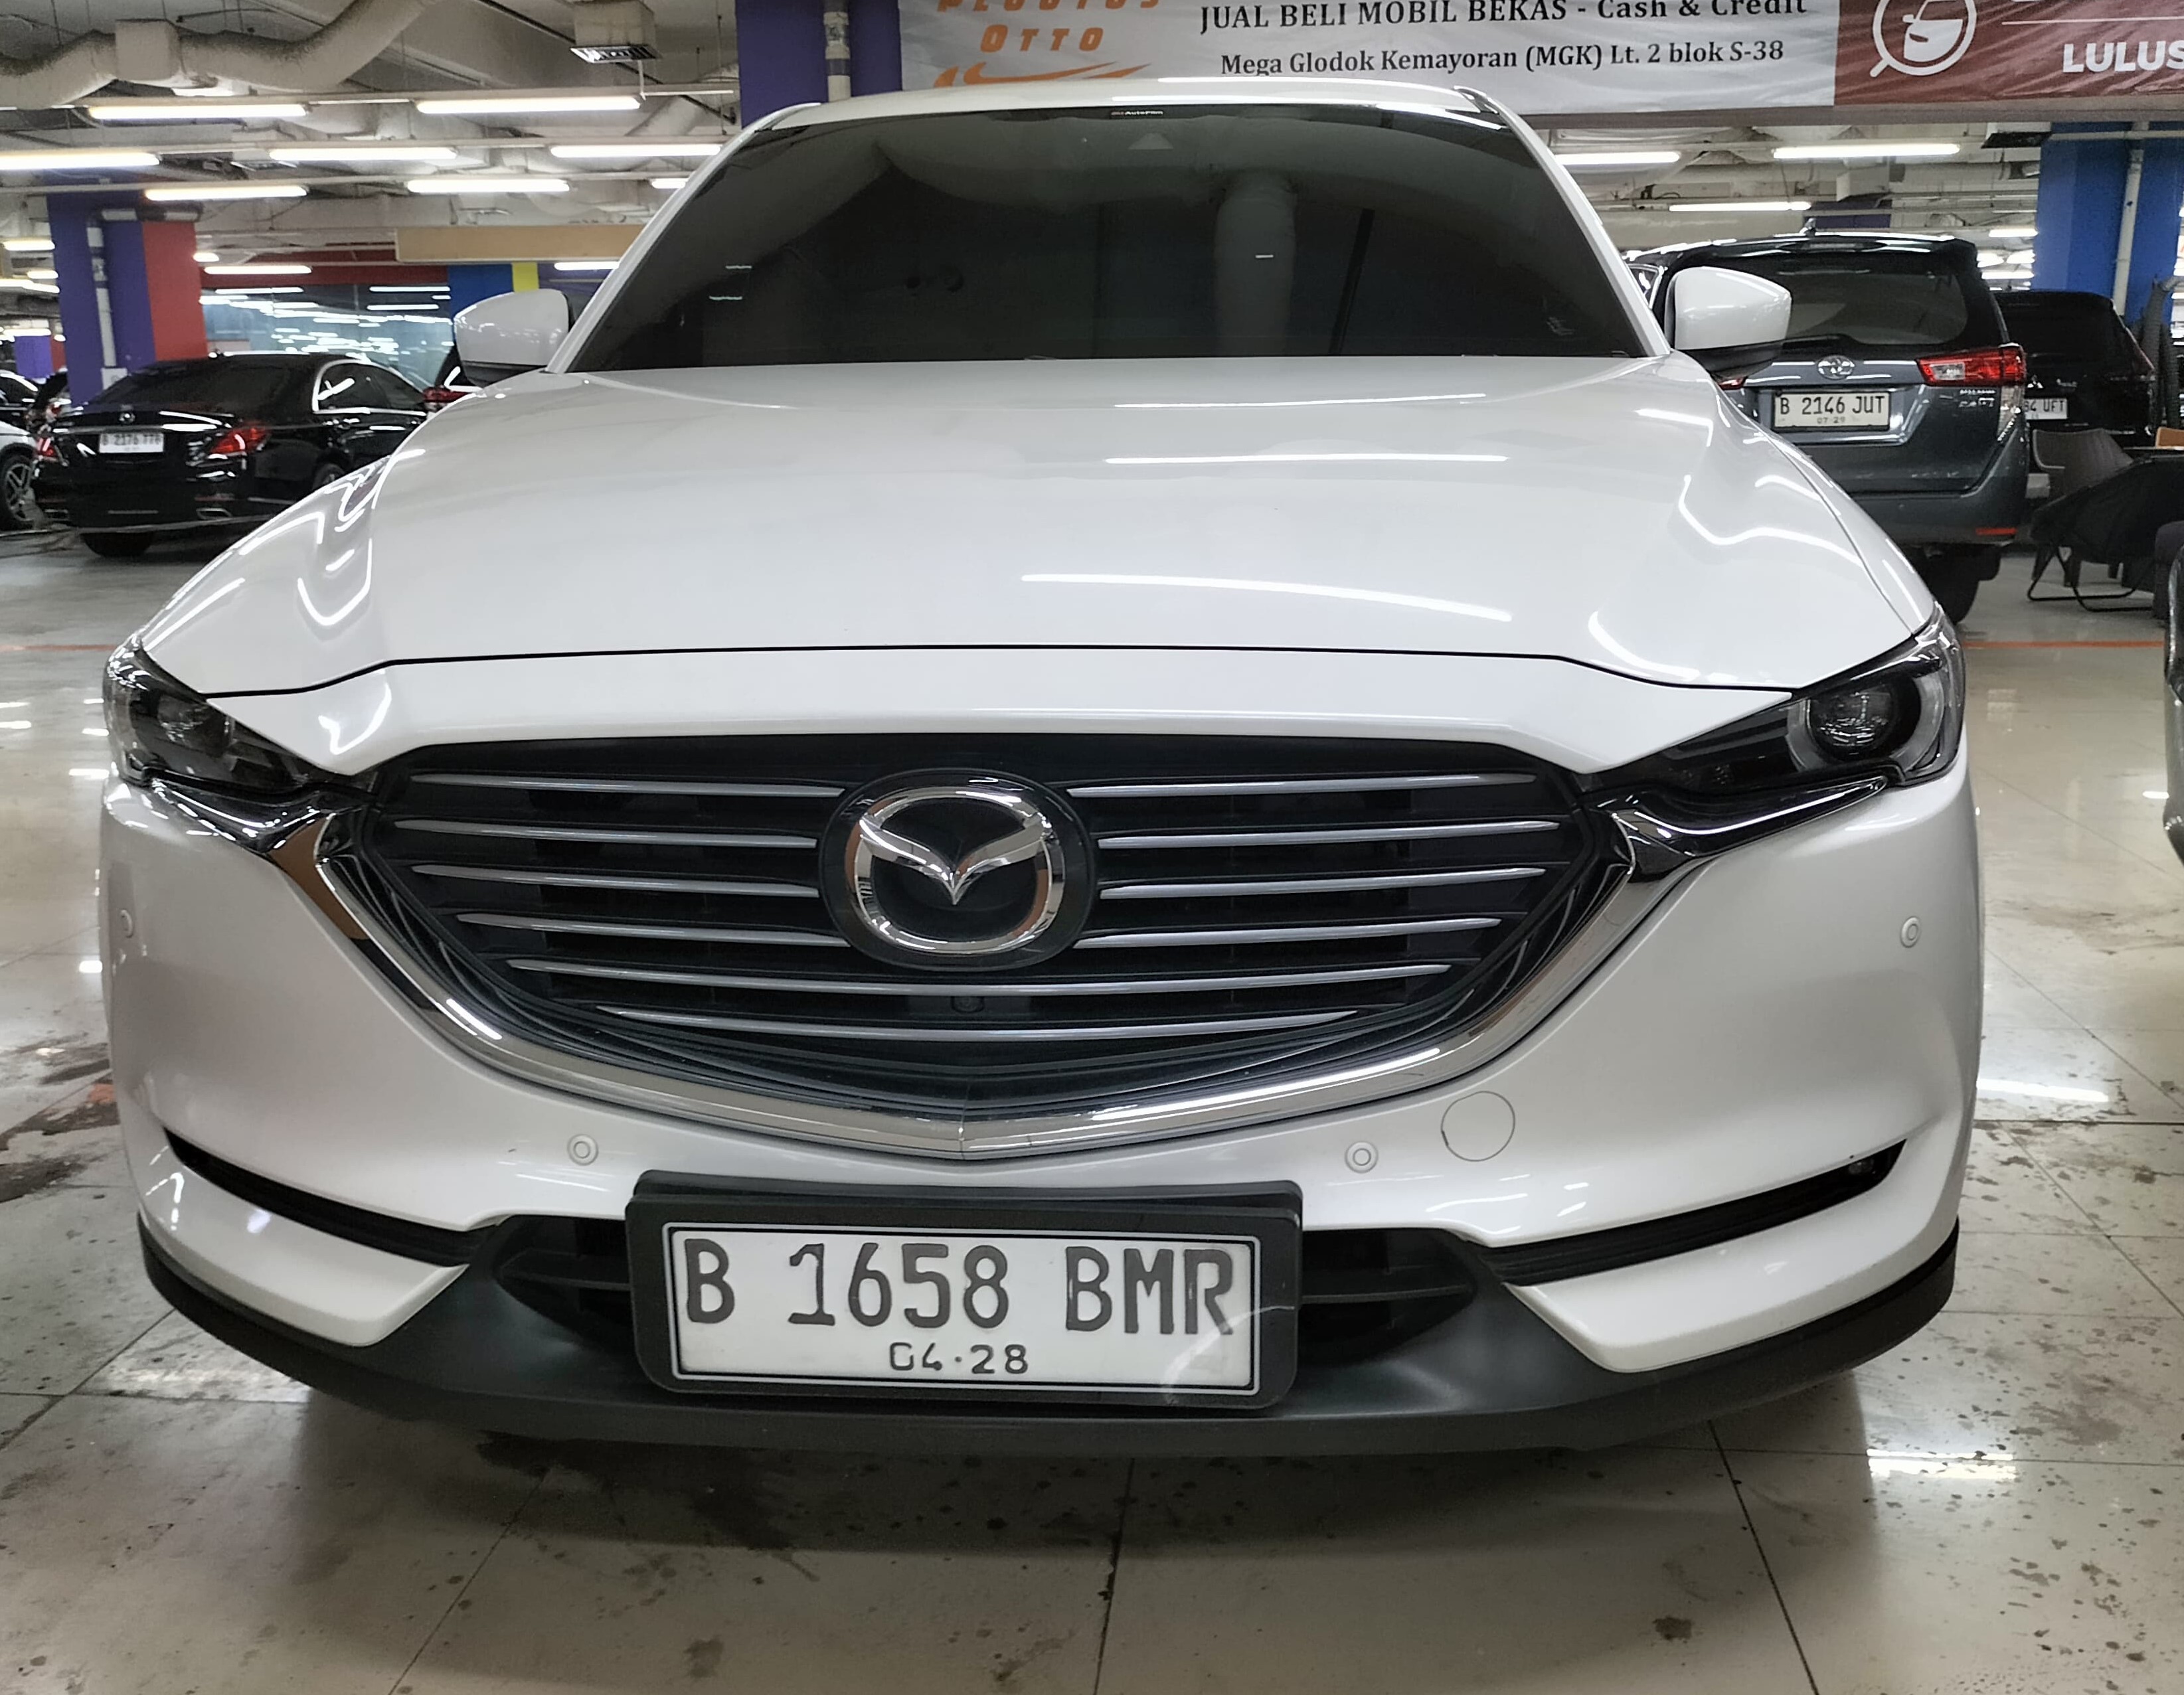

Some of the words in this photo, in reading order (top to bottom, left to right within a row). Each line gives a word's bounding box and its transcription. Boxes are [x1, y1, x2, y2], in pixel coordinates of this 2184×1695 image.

[1201, 5, 1270, 35] JUAL
[1280, 3, 1347, 28] BELI
[1358, 0, 1458, 25] MOBIL
[1468, 0, 1568, 23] BEKAS
[1598, 0, 1668, 19] Cash
[1678, 0, 1701, 17] &
[1711, 0, 1808, 17] Credit
[979, 24, 1104, 53] OTTO
[1221, 54, 1283, 77] Mega
[1290, 50, 1375, 73] Glodok
[1381, 50, 1517, 75] Kemayoran
[1525, 44, 1602, 72] (MGK)
[1610, 44, 1640, 65] Lt.
[1647, 43, 1661, 64] 2
[1669, 41, 1724, 63] blok
[1729, 40, 1784, 62] S-38
[2062, 39, 2184, 74] LULUS
[1780, 396, 1790, 416] B
[1802, 396, 1846, 415] 2146
[1851, 395, 1886, 414] JUT
[684, 1238, 736, 1325] B
[788, 1242, 1009, 1329] 1658
[1063, 1245, 1235, 1336] BMR
